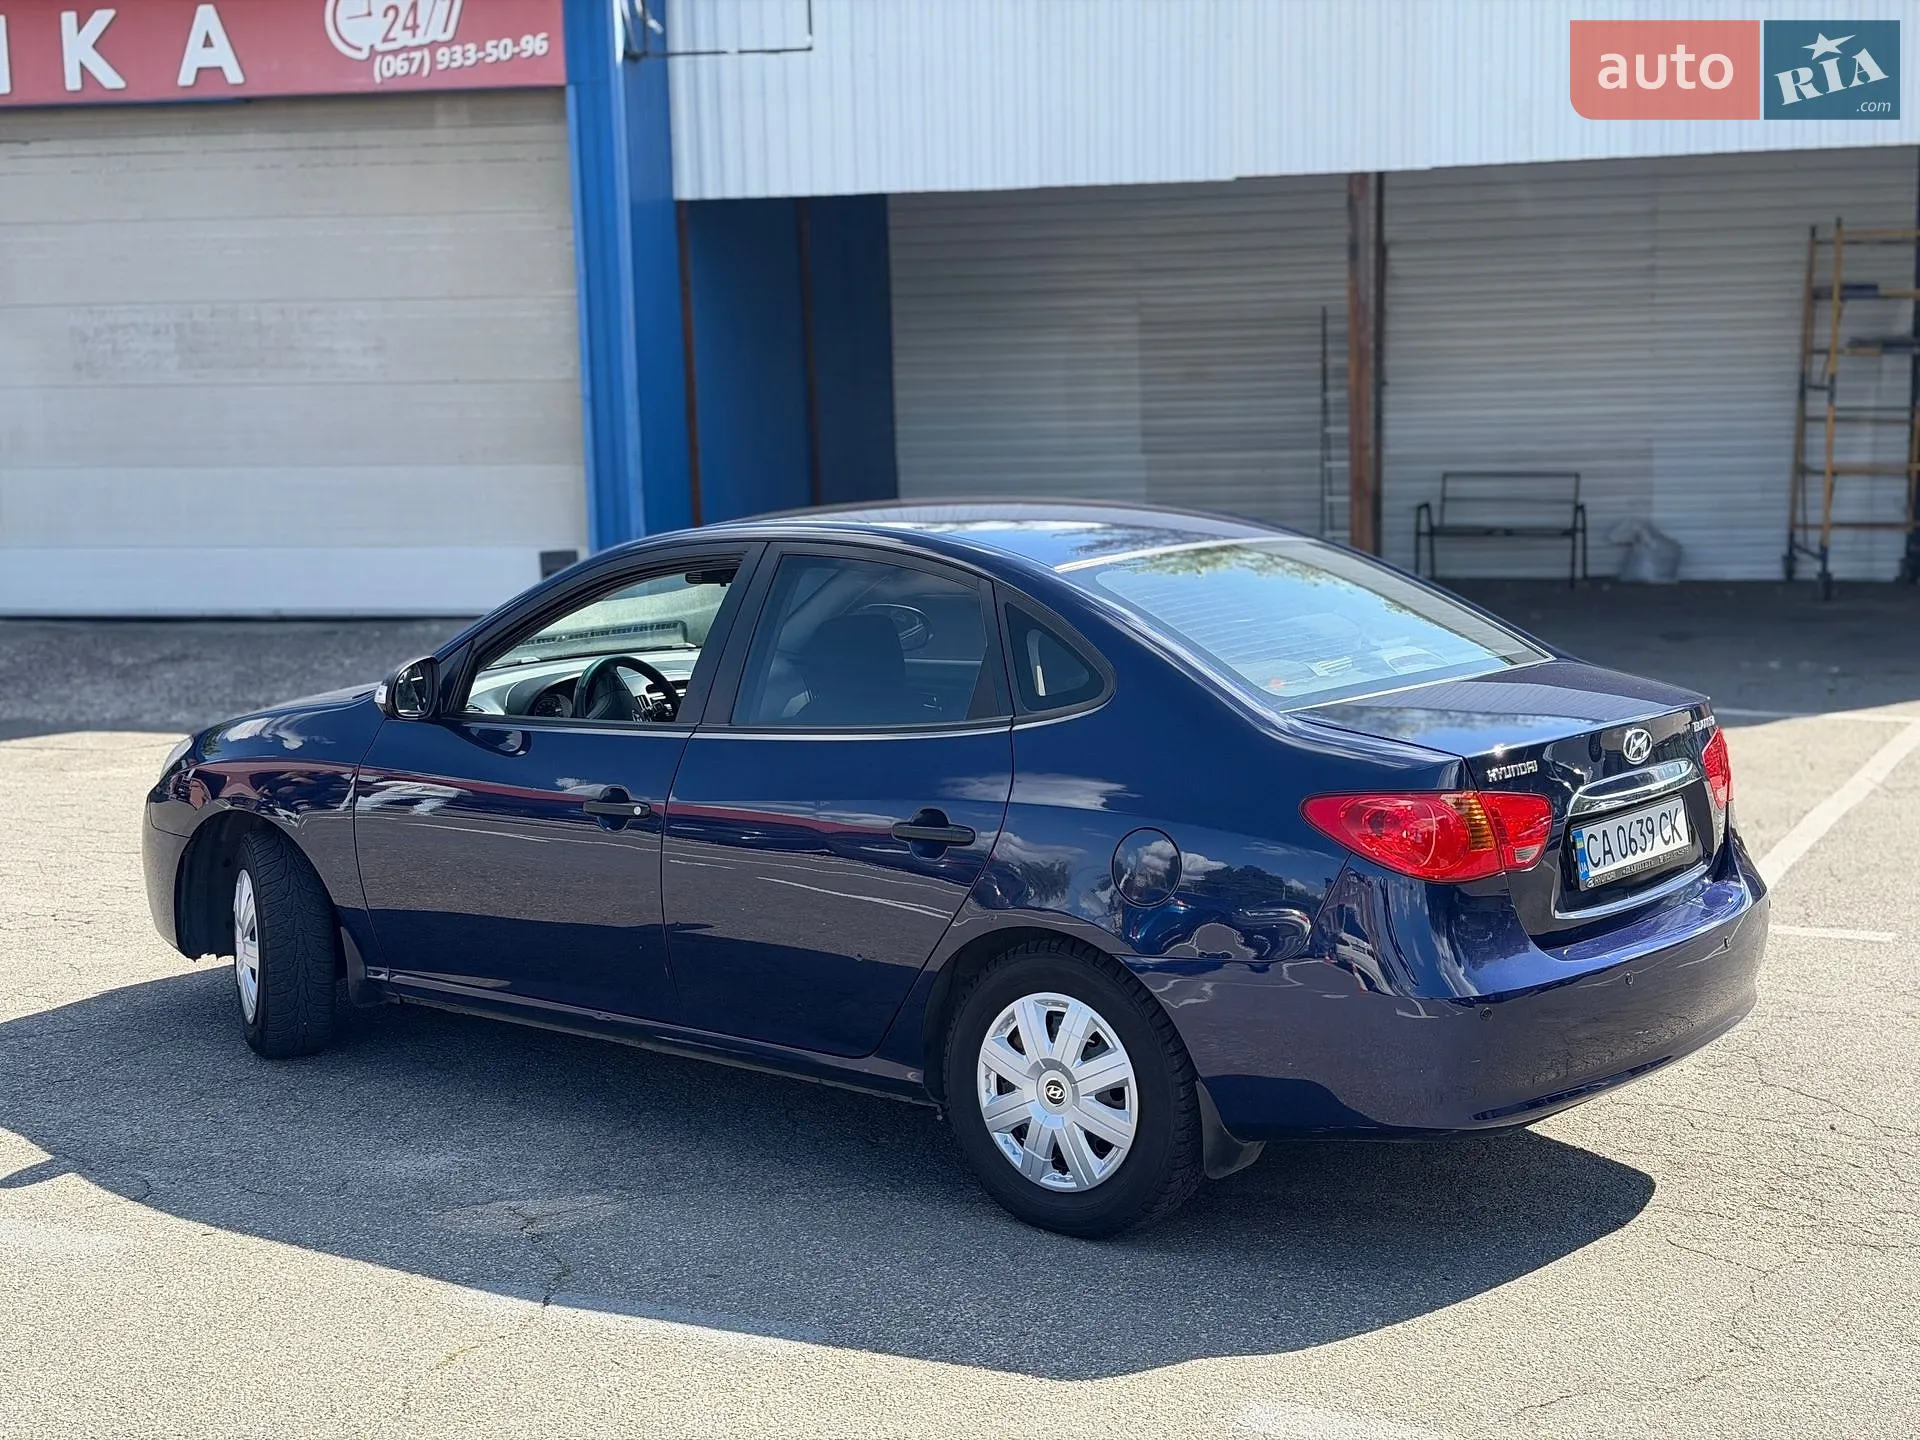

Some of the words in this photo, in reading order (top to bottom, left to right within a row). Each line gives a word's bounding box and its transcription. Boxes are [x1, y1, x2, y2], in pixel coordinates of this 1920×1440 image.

[373, 48, 431, 84] (067)
[435, 32, 549, 70] 933-50-96
[1486, 760, 1538, 782] HYUNDAI
[1587, 829, 1615, 868] CA
[1616, 816, 1655, 859] 0639
[1659, 807, 1683, 846] CK
